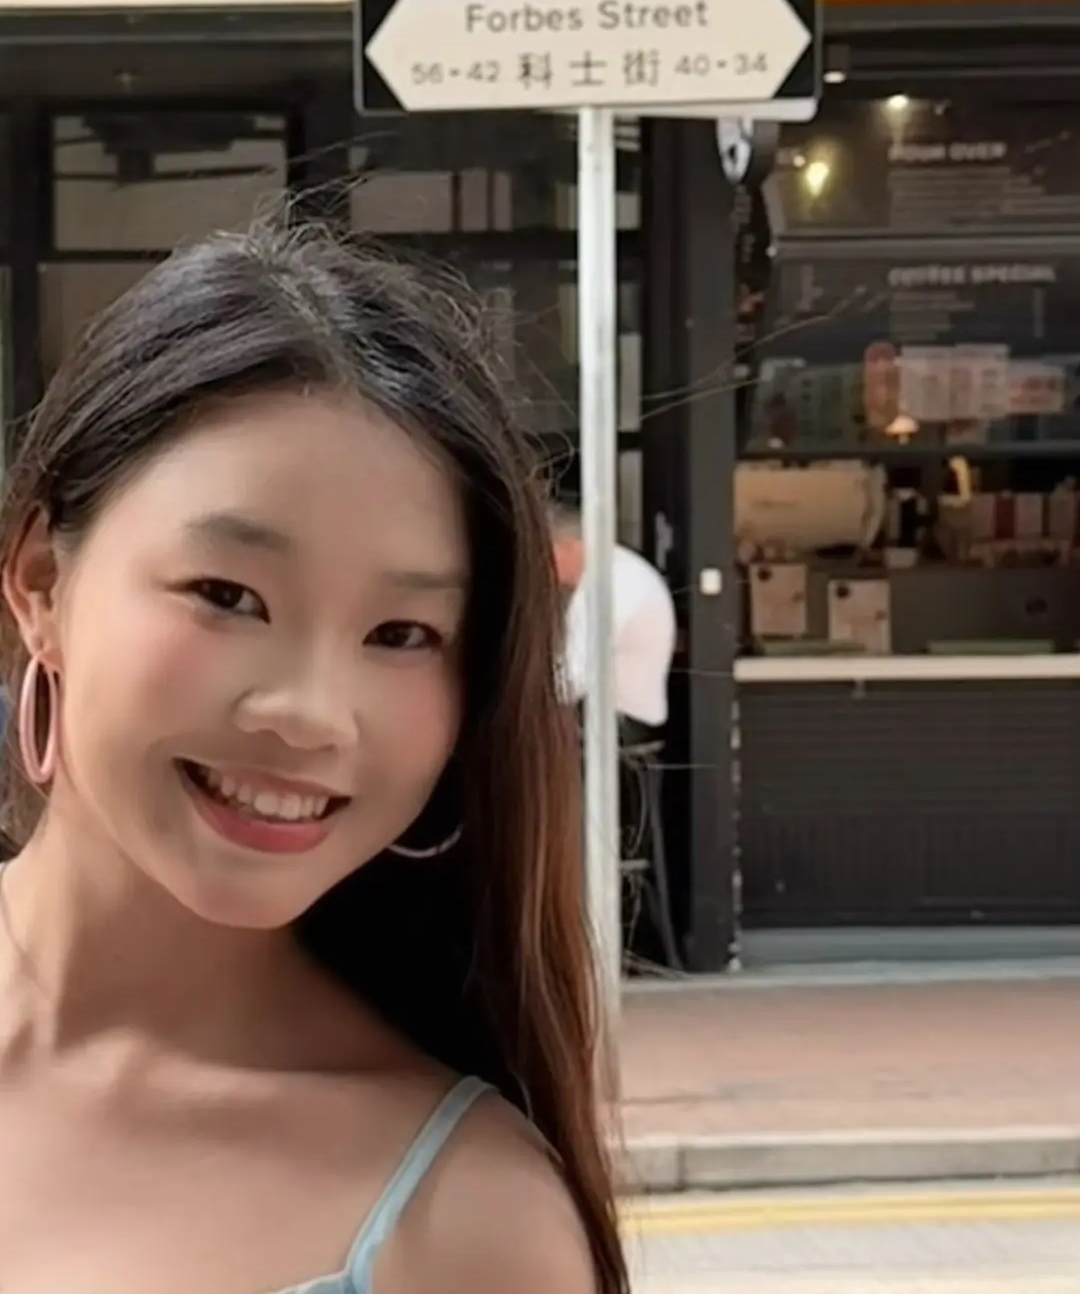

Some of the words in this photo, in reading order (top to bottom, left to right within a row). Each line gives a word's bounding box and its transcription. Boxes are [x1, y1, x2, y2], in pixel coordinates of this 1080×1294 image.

[464, 3, 584, 35] Forbes
[597, 0, 709, 31] Street
[517, 50, 661, 89] 科士街
